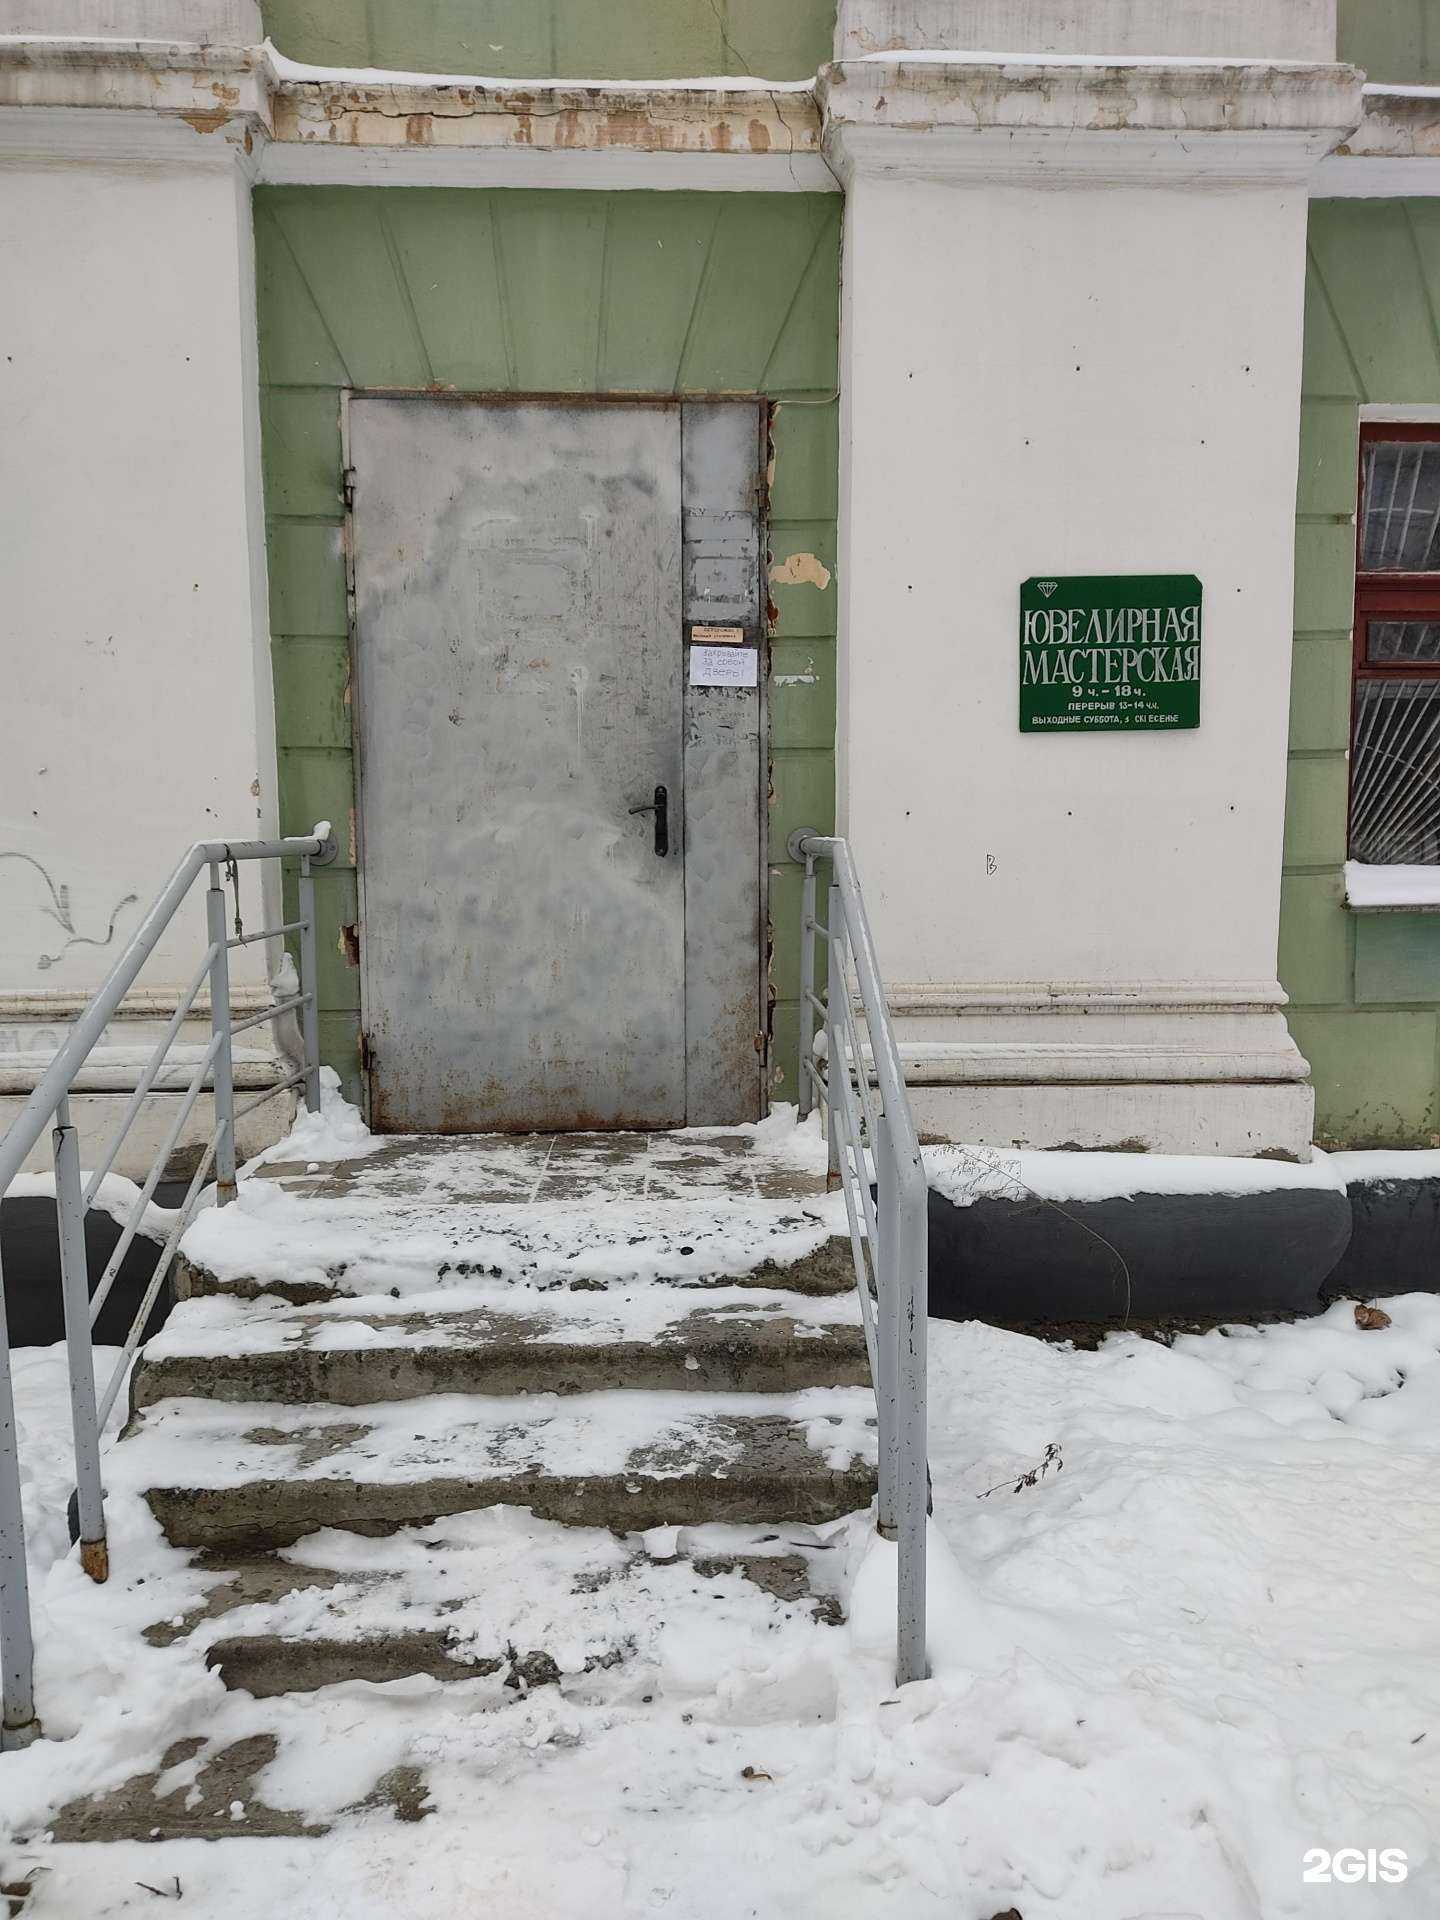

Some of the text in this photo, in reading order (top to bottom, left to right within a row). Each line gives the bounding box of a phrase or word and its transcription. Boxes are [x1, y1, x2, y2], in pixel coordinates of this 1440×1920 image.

[1023, 606, 1200, 645] ЮВЕЛИРНАЯ
[1022, 646, 1200, 685] МАСТЕРСКАЯ
[1067, 702, 1116, 712] ПЕРЕРЫВ
[1031, 715, 1082, 726] ВЫХОДНЫЕ
[1083, 715, 1123, 725] СУББОТА,
